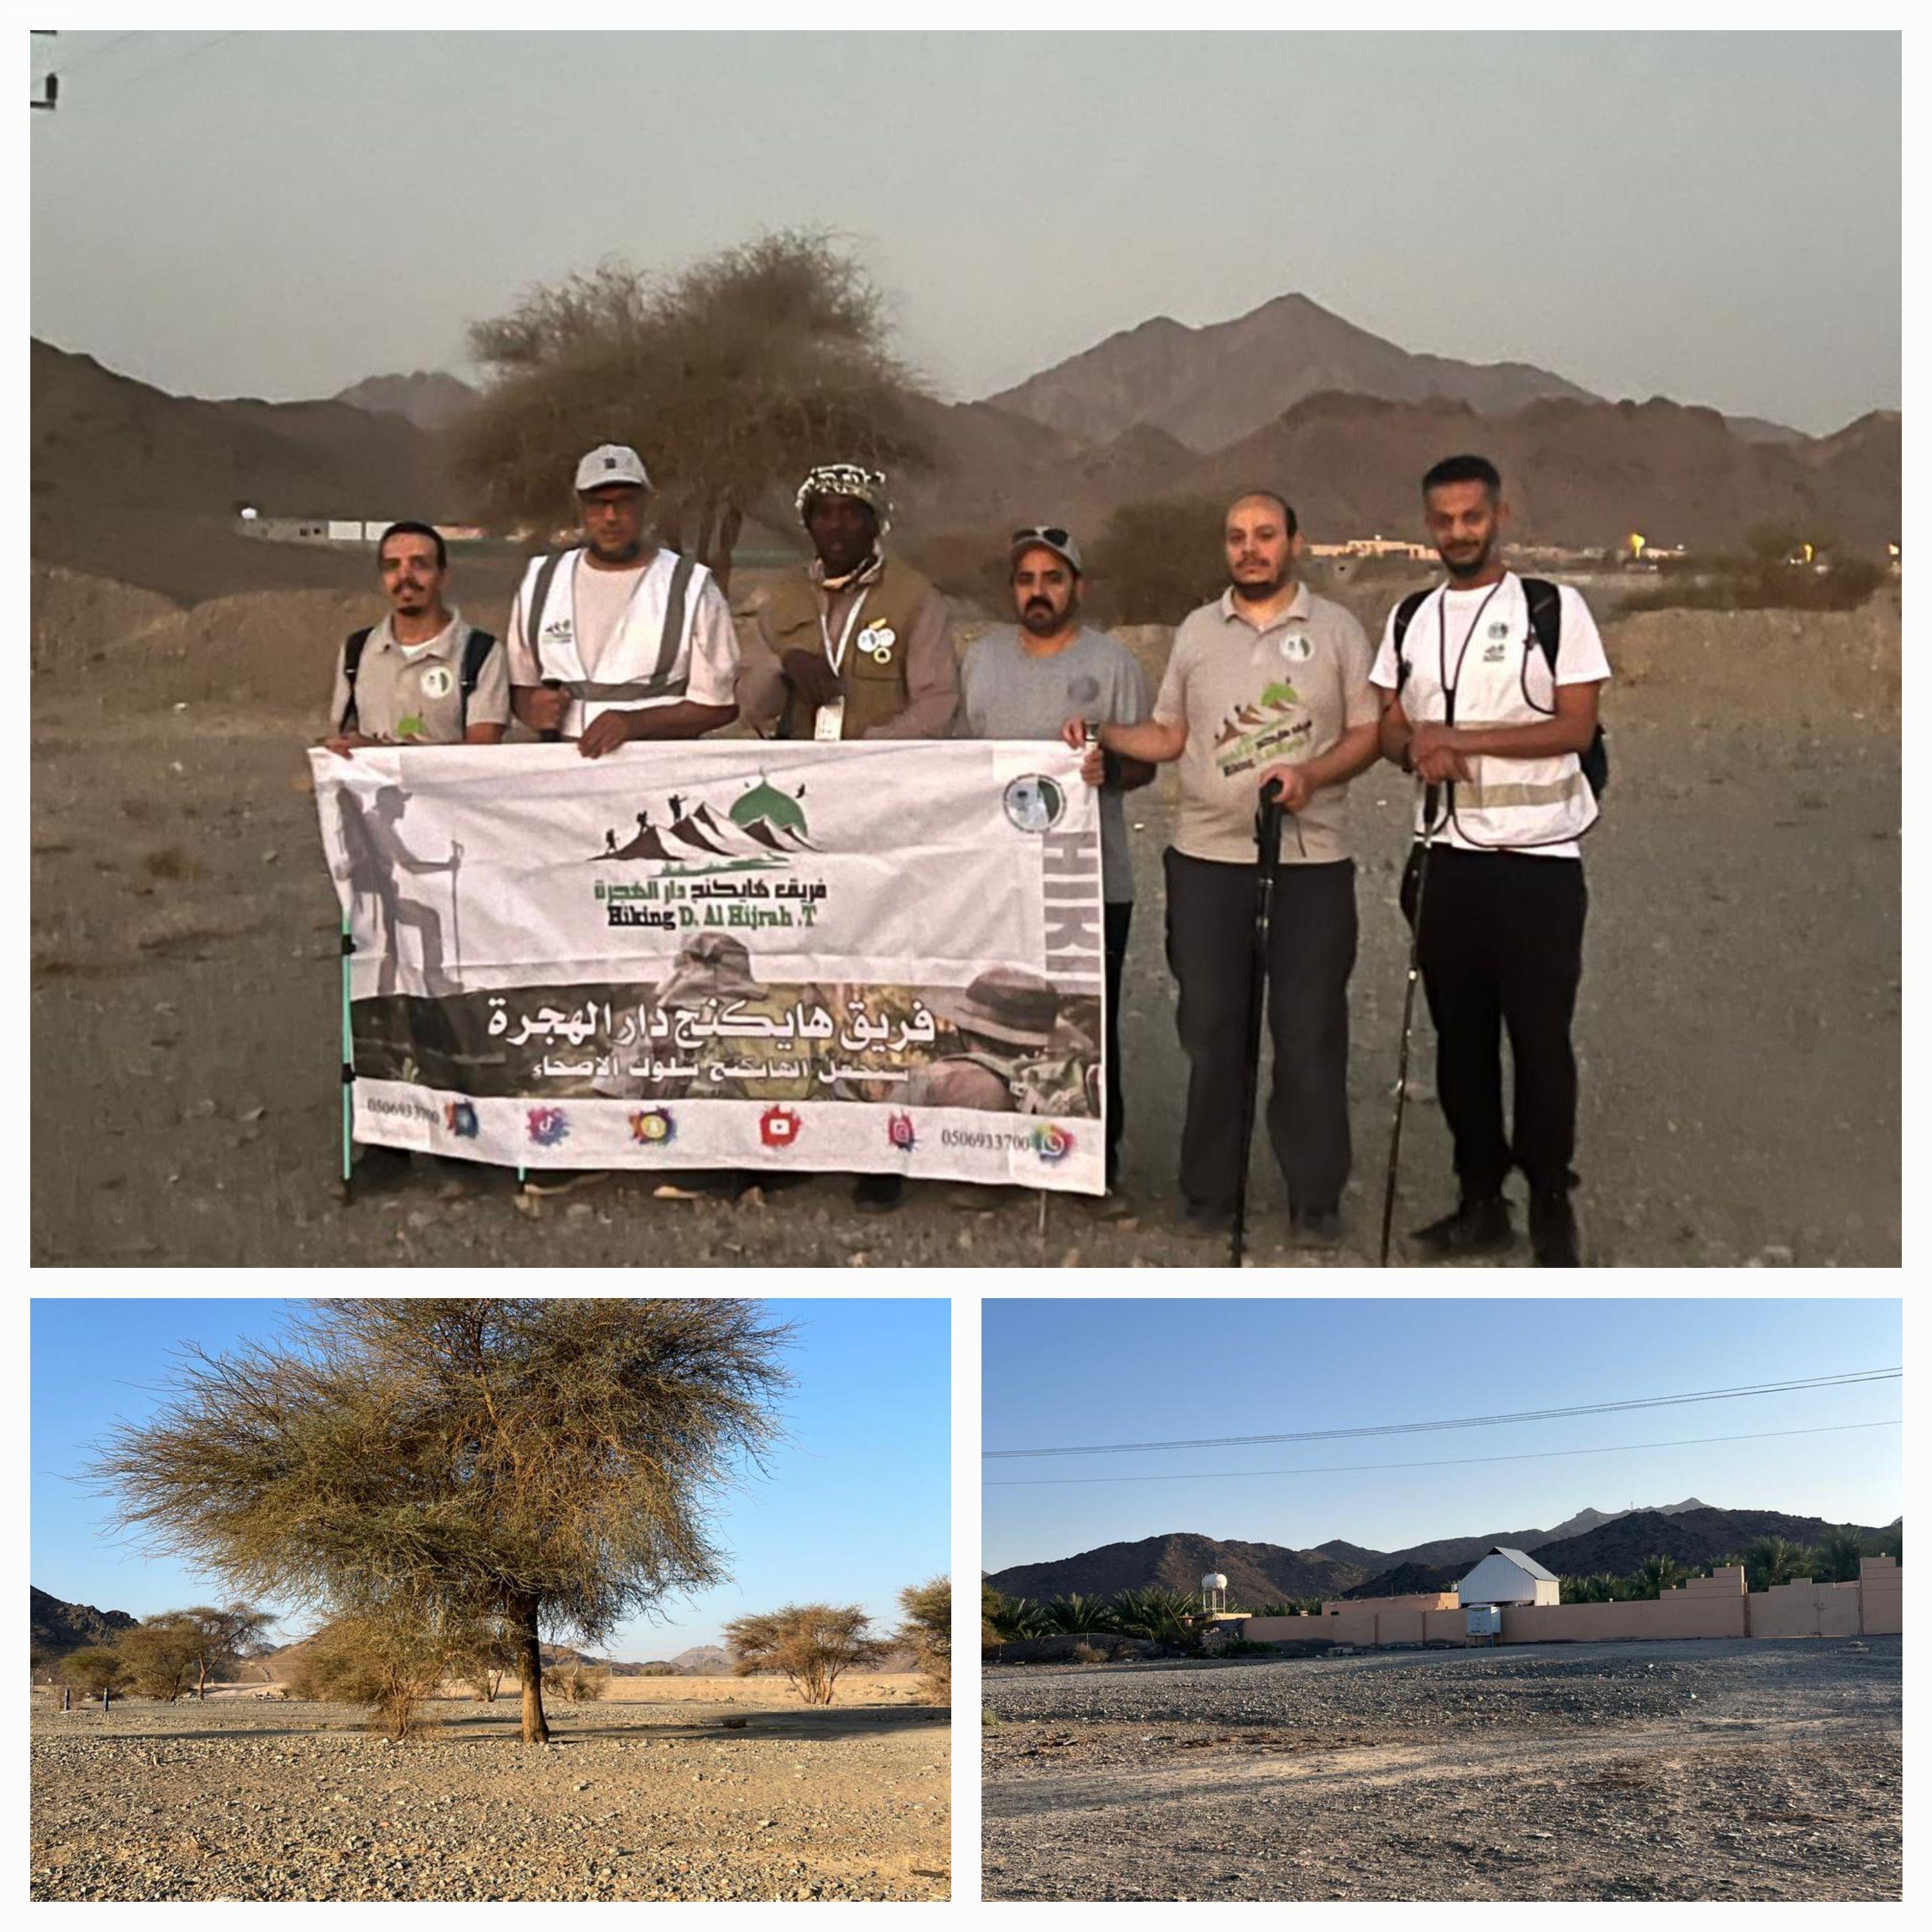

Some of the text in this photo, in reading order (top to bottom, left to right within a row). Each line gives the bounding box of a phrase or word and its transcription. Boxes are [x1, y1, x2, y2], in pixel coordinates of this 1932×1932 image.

[594, 878, 827, 905] فريق هايكنج دار الهجرة
[608, 906, 676, 930] Hiking
[679, 907, 698, 926] D.
[704, 906, 723, 926] Al
[728, 906, 792, 930] Hijrah
[488, 998, 936, 1051] فريق هايكنج دار الهجرة
[629, 1057, 698, 1082] سلوك
[941, 1128, 1030, 1152] 0506933700
